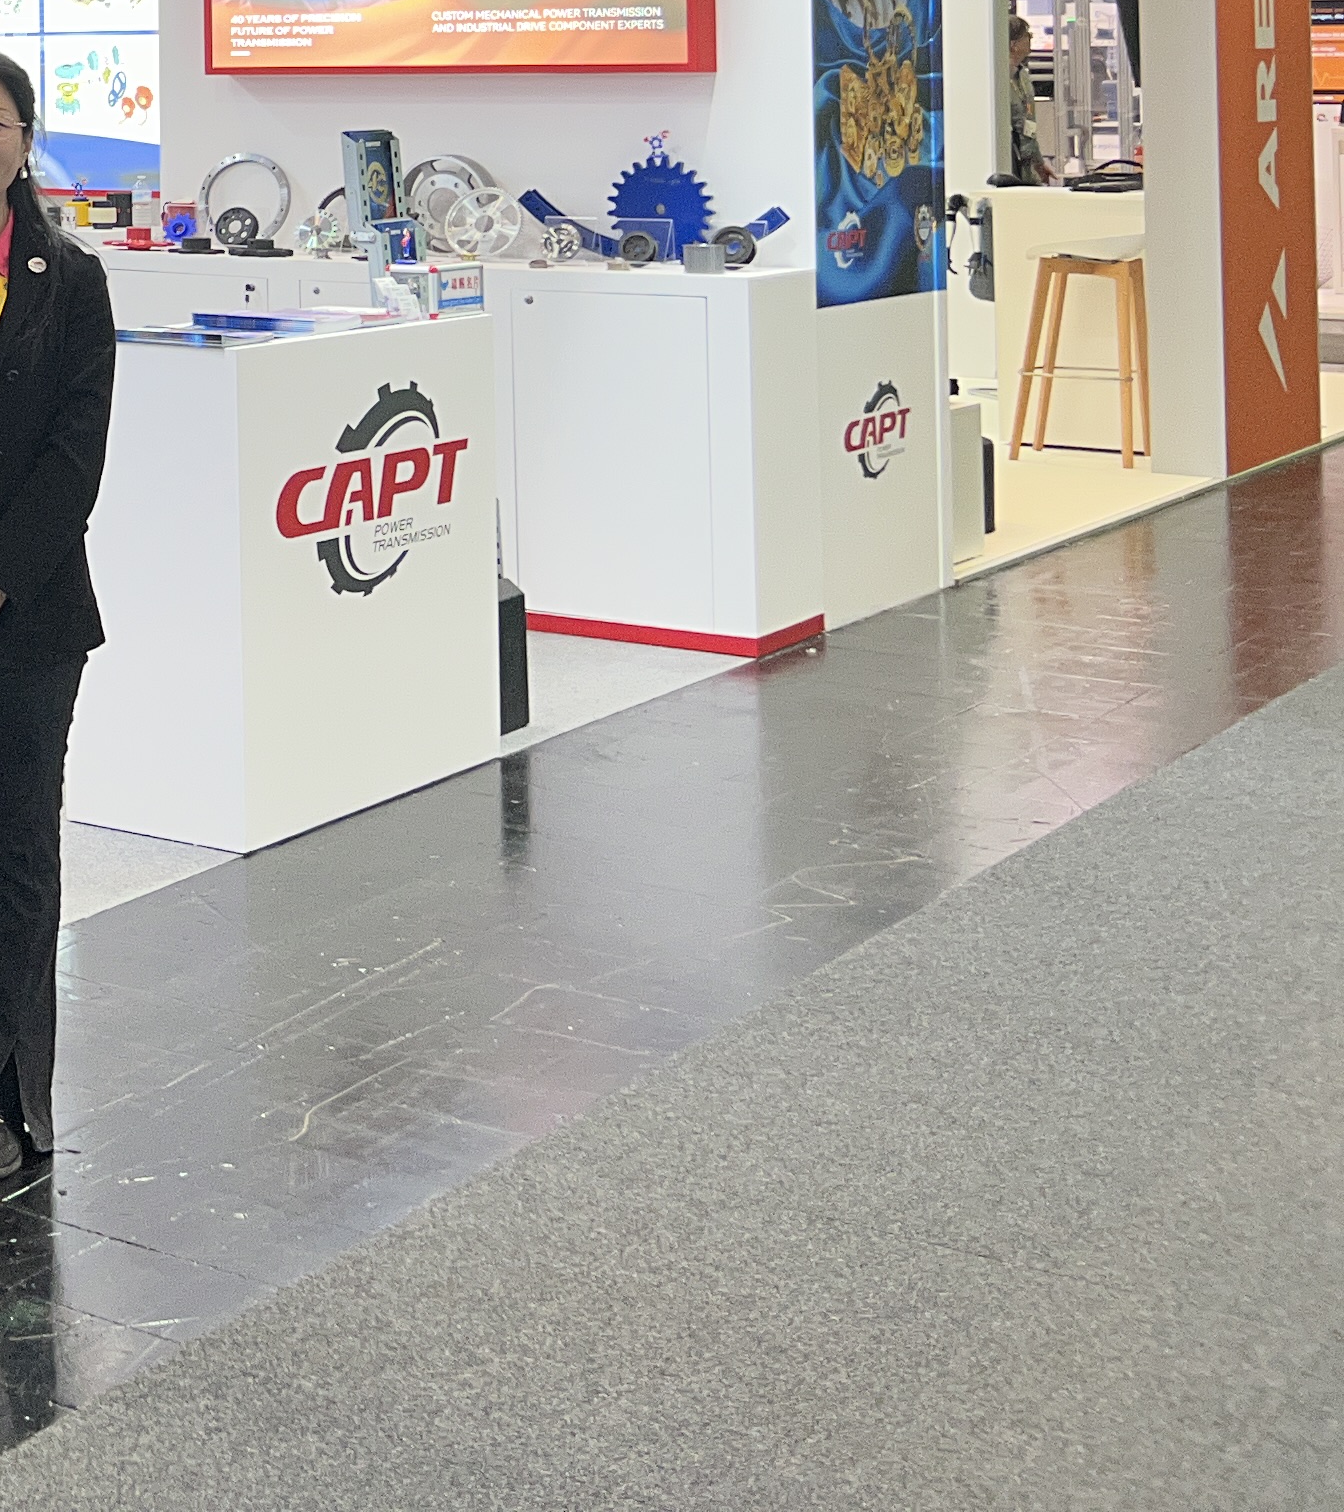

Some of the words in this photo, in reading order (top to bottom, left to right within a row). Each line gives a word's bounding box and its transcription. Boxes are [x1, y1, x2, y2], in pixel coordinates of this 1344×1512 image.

[247, 14, 282, 24] YEARS
[283, 14, 299, 24] OF
[431, 10, 474, 21] CUSTOM
[475, 9, 542, 21] MECHANICAL
[543, 8, 581, 19] POWER
[582, 6, 662, 18] TRANSMISSION
[230, 26, 274, 36] FUTURE
[276, 26, 292, 36] OF
[293, 25, 334, 36] POWER
[431, 21, 454, 33] AND
[456, 21, 516, 33] INDUSTRIAL
[516, 21, 547, 32] DRIVE
[548, 20, 615, 31] COMPONENT
[617, 19, 665, 30] EXPERTS
[230, 38, 313, 48] TRANSMISSION
[844, 407, 912, 454] CAPT
[276, 438, 469, 539] CAPT
[374, 517, 414, 538] POWER
[372, 523, 451, 553] TRANSMISSION
